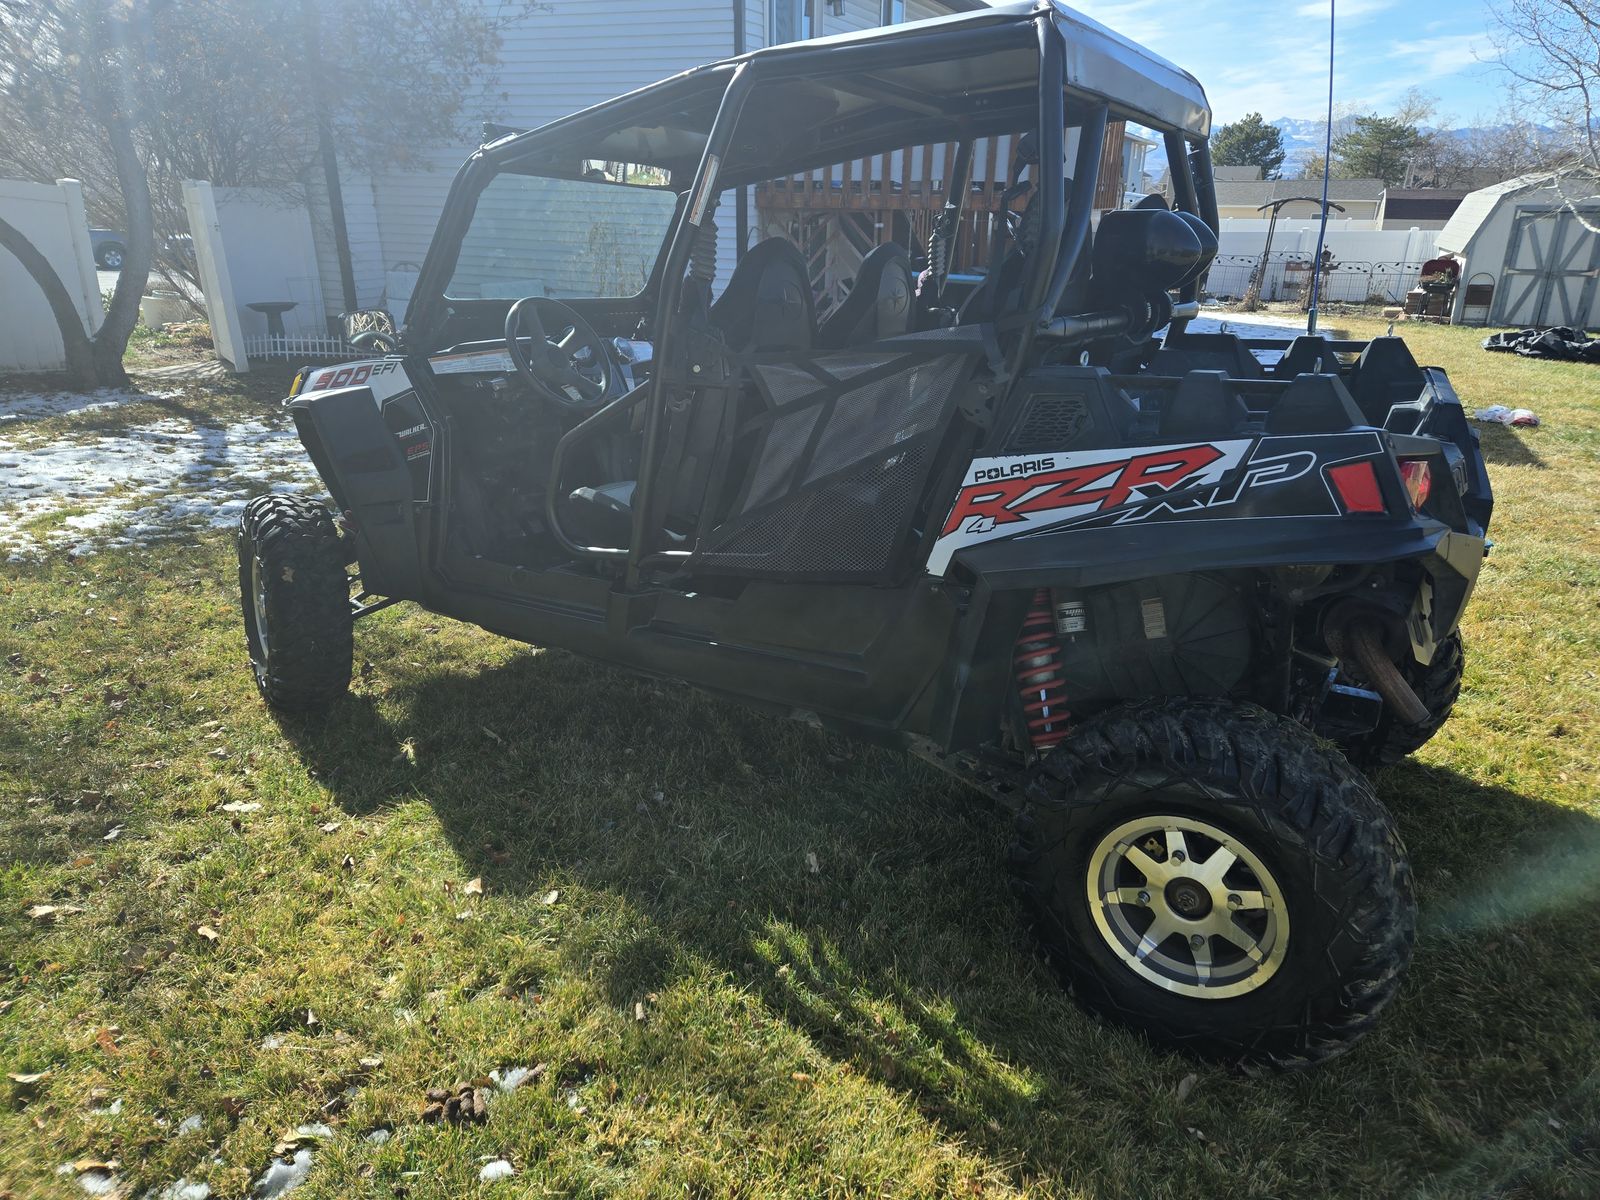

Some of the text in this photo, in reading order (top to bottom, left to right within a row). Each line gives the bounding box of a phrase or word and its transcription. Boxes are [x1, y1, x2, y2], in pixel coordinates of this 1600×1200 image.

[312, 362, 398, 389] 900 EFI
[974, 457, 1055, 482] POLARIS
[937, 443, 1226, 541] RZR
[965, 514, 998, 534] 4
